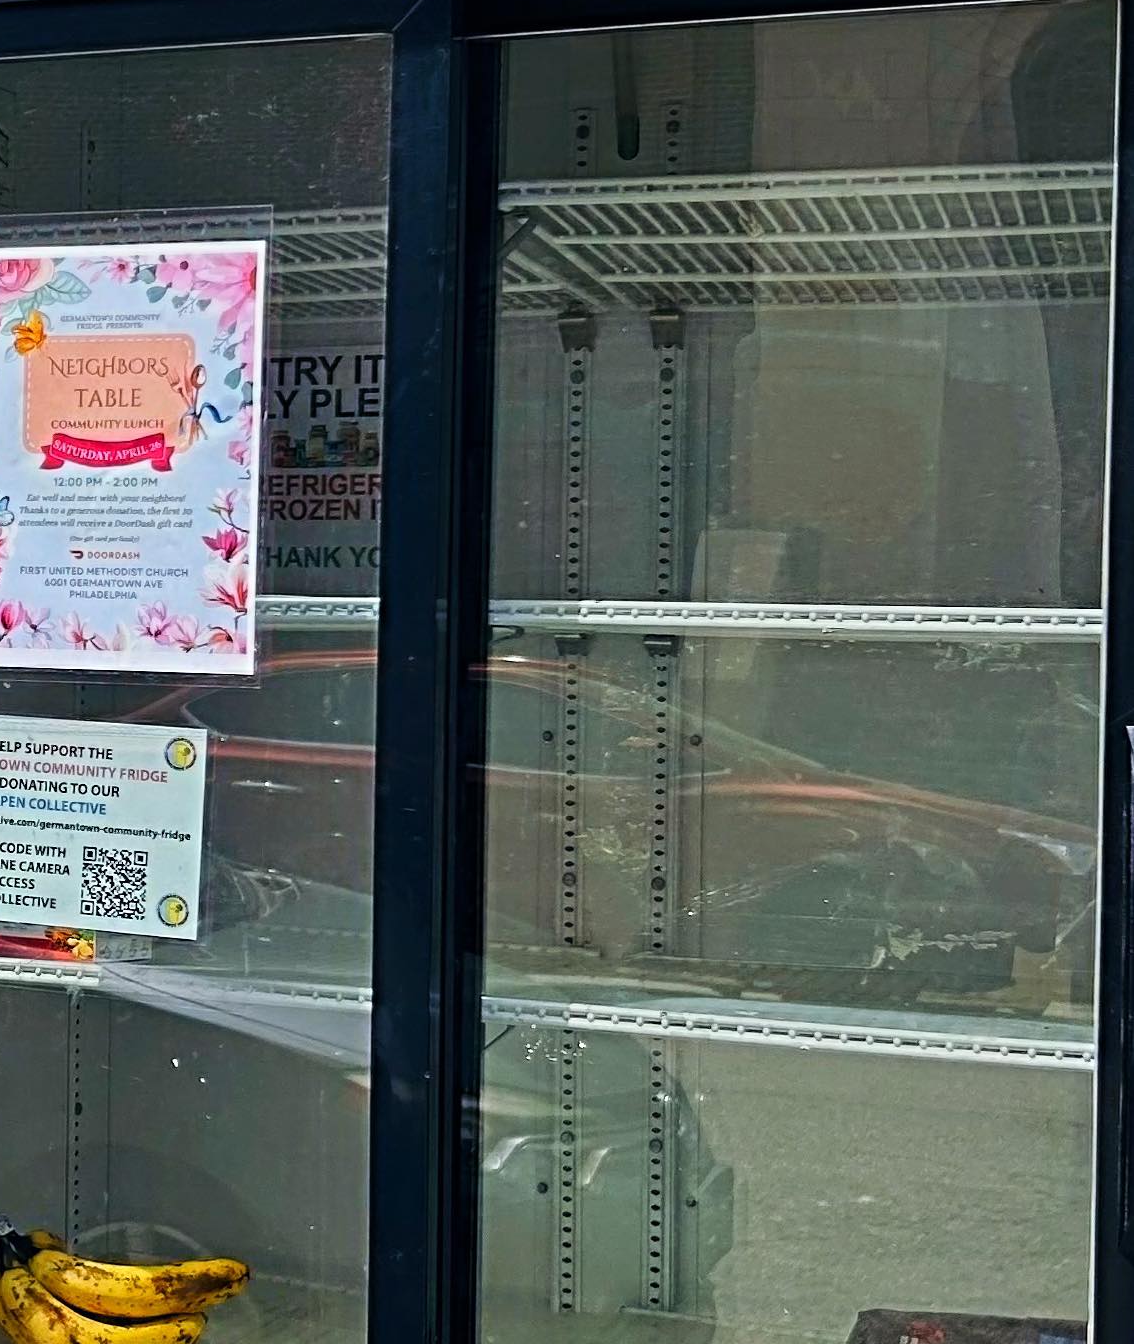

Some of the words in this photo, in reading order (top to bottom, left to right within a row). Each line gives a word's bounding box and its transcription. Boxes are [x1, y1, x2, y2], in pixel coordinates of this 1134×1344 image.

[49, 355, 169, 378] NEIGHBORS
[263, 354, 341, 386] TRY
[74, 388, 142, 408] TABLE
[309, 387, 380, 418] PLE
[51, 419, 121, 430] COMMUNITY
[124, 419, 164, 429] LUNCH
[52, 440, 114, 462] SATURDAY,
[116, 445, 147, 460] APRIL
[53, 477, 83, 487] 12:00
[85, 477, 102, 487] PM
[113, 477, 138, 487] 2:00
[141, 478, 158, 487] PM
[26, 494, 40, 502] Eat
[41, 494, 59, 502] well
[60, 494, 76, 502] and
[100, 494, 118, 502] with
[119, 496, 139, 504] your
[19, 506, 49, 514] Thanks
[67, 508, 105, 516] generous
[147, 507, 161, 515] the
[161, 507, 180, 515] first
[18, 519, 59, 527] attendees
[60, 519, 75, 527] will
[114, 519, 156, 528] DoorDash
[157, 519, 171, 529] gift
[173, 520, 193, 528] card
[87, 552, 140, 560] DOORDASH
[264, 546, 341, 568] HANK
[19, 566, 47, 575] FIRST
[48, 567, 84, 576] UNITED
[86, 567, 144, 577] METHODIST
[145, 568, 189, 577] CHURCH
[69, 578, 142, 588] GERMANTOWN
[143, 580, 163, 589] AVE
[69, 590, 137, 600] PHILADELPHIA
[24, 742, 85, 759] SUPPORT
[88, 746, 114, 761] THE
[33, 761, 117, 780] COMMUNITY
[119, 767, 169, 784] FRIDGE
[0, 777, 69, 795] DONATING
[70, 782, 89, 796] TO
[91, 783, 120, 798] OUR
[28, 797, 107, 816] COLLECTIVE
[0, 841, 33, 856] CODE
[34, 844, 67, 858] WITH
[19, 861, 71, 876] CAMERA
